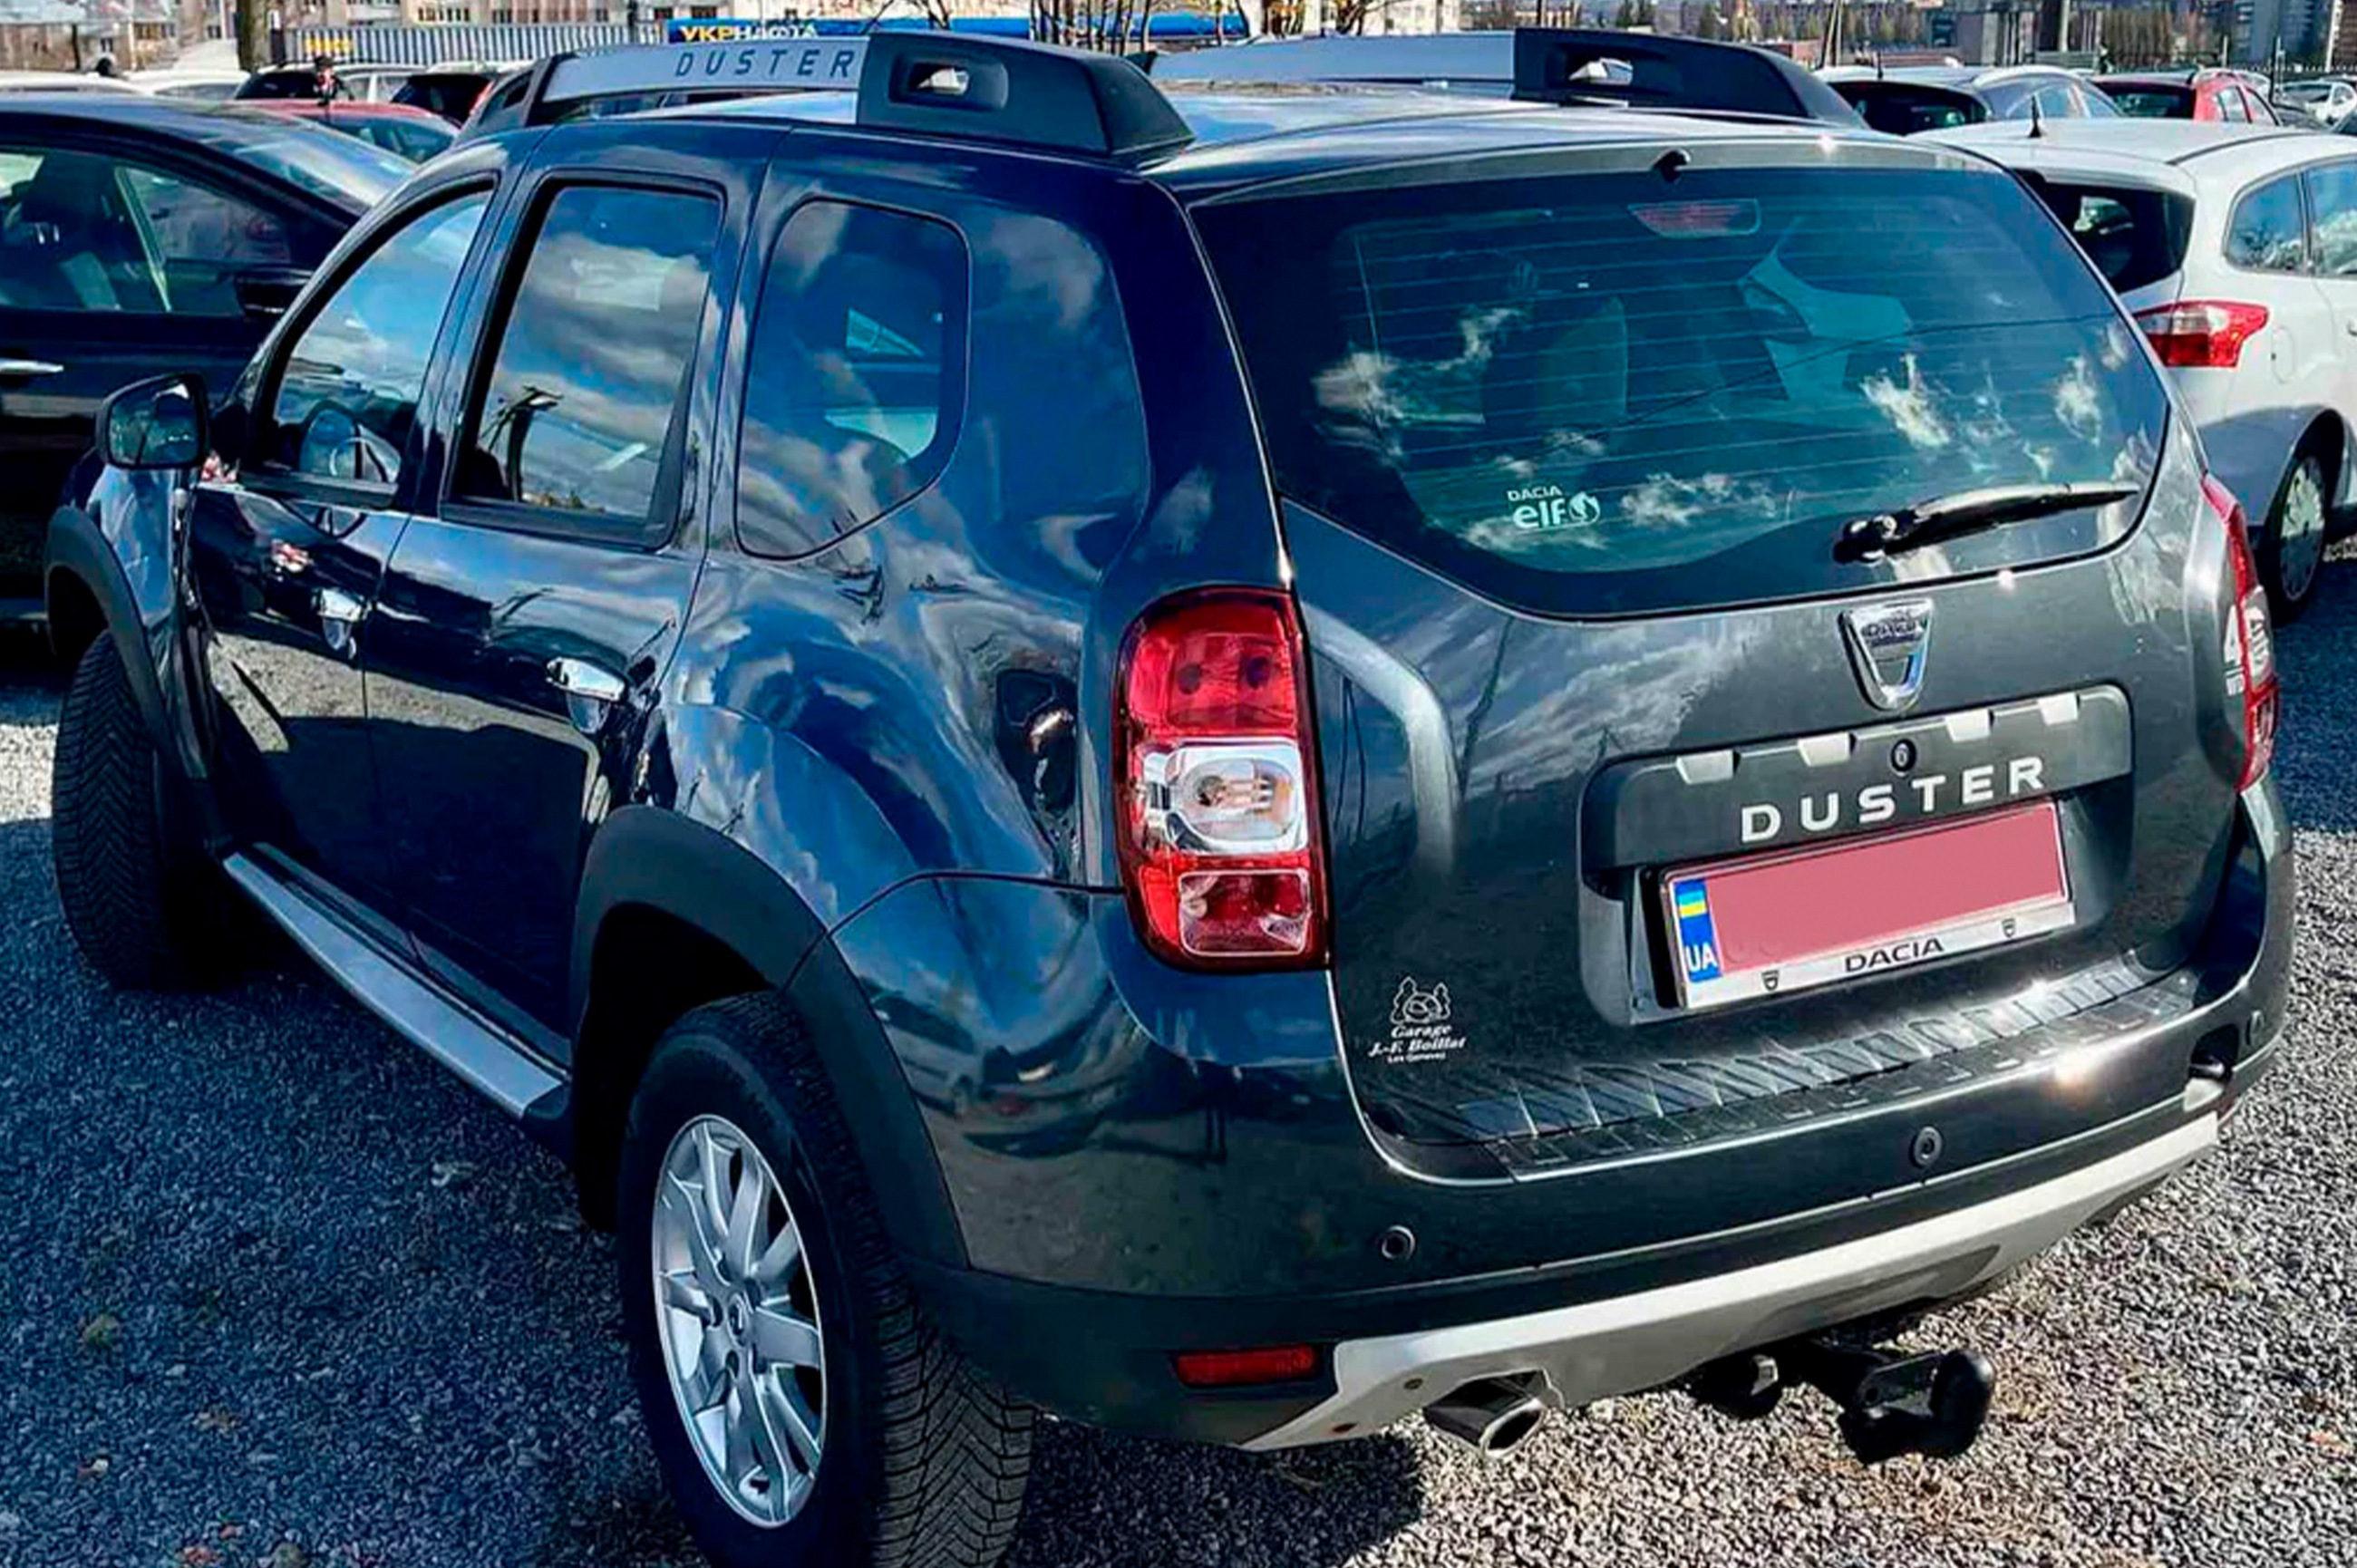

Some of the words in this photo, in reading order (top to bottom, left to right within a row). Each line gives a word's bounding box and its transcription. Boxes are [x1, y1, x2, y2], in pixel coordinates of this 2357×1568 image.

[675, 48, 855, 78] DUSTER
[1507, 485, 1563, 502] DACIA
[1513, 498, 1566, 528] elf
[1741, 756, 2045, 843] DUSTER
[1685, 945, 1719, 973] UA
[1844, 937, 1945, 973] DACIA
[1391, 1025, 1452, 1039] Garage
